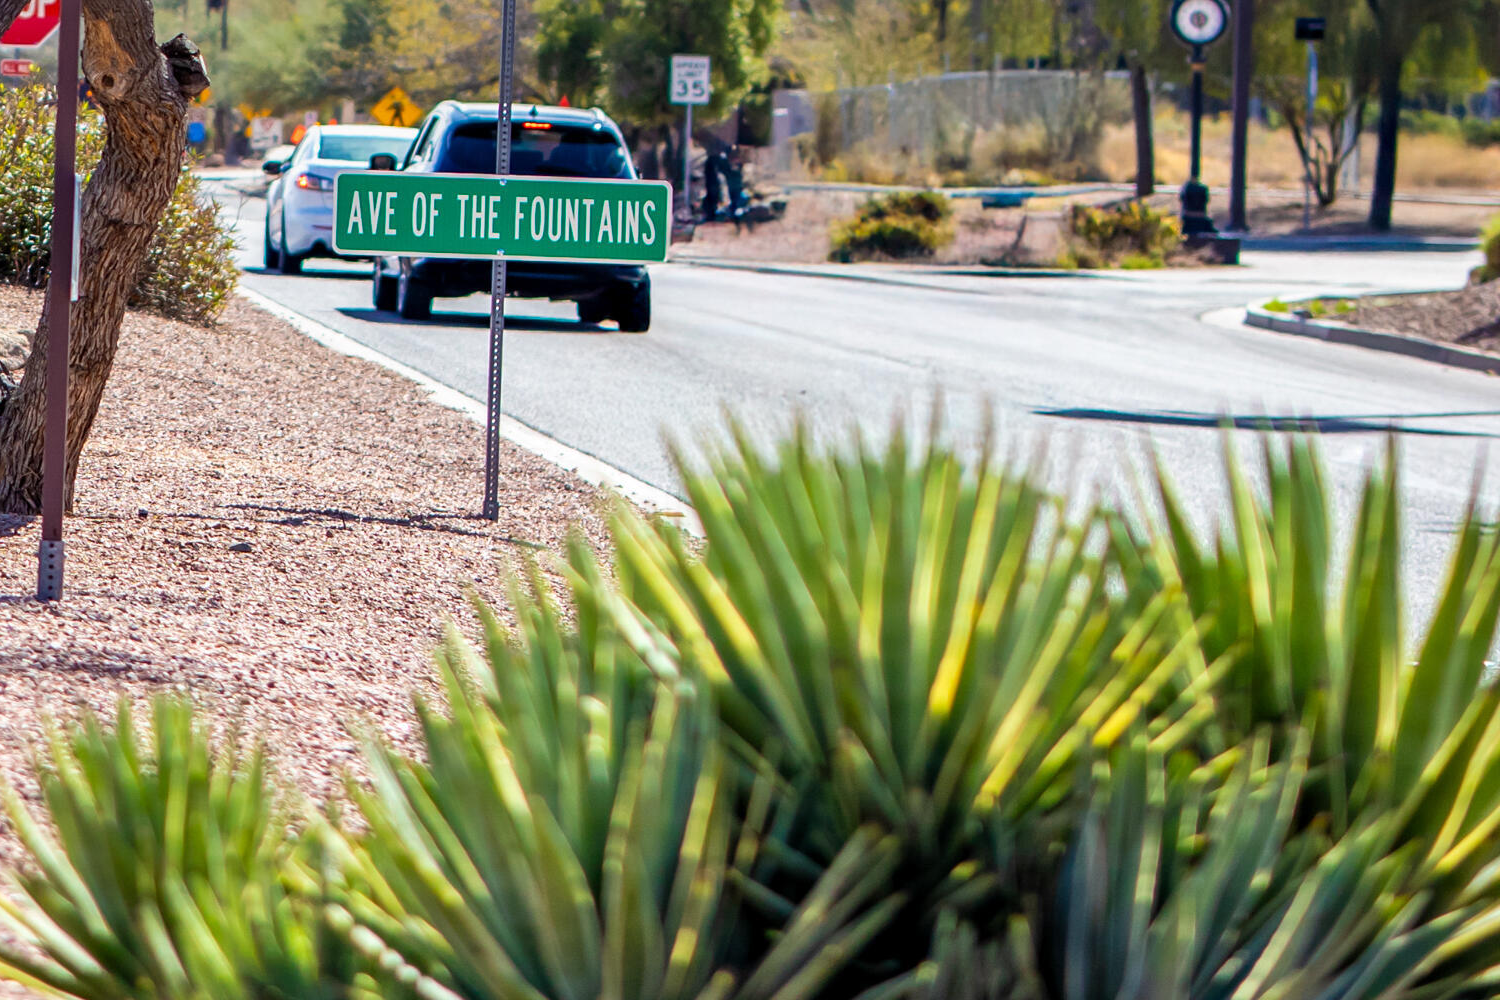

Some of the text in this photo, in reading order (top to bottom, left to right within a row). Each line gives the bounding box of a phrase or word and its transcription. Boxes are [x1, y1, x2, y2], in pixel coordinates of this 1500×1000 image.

[676, 80, 705, 97] 35
[347, 190, 656, 245] AVE OF THE FOUNTAINS
